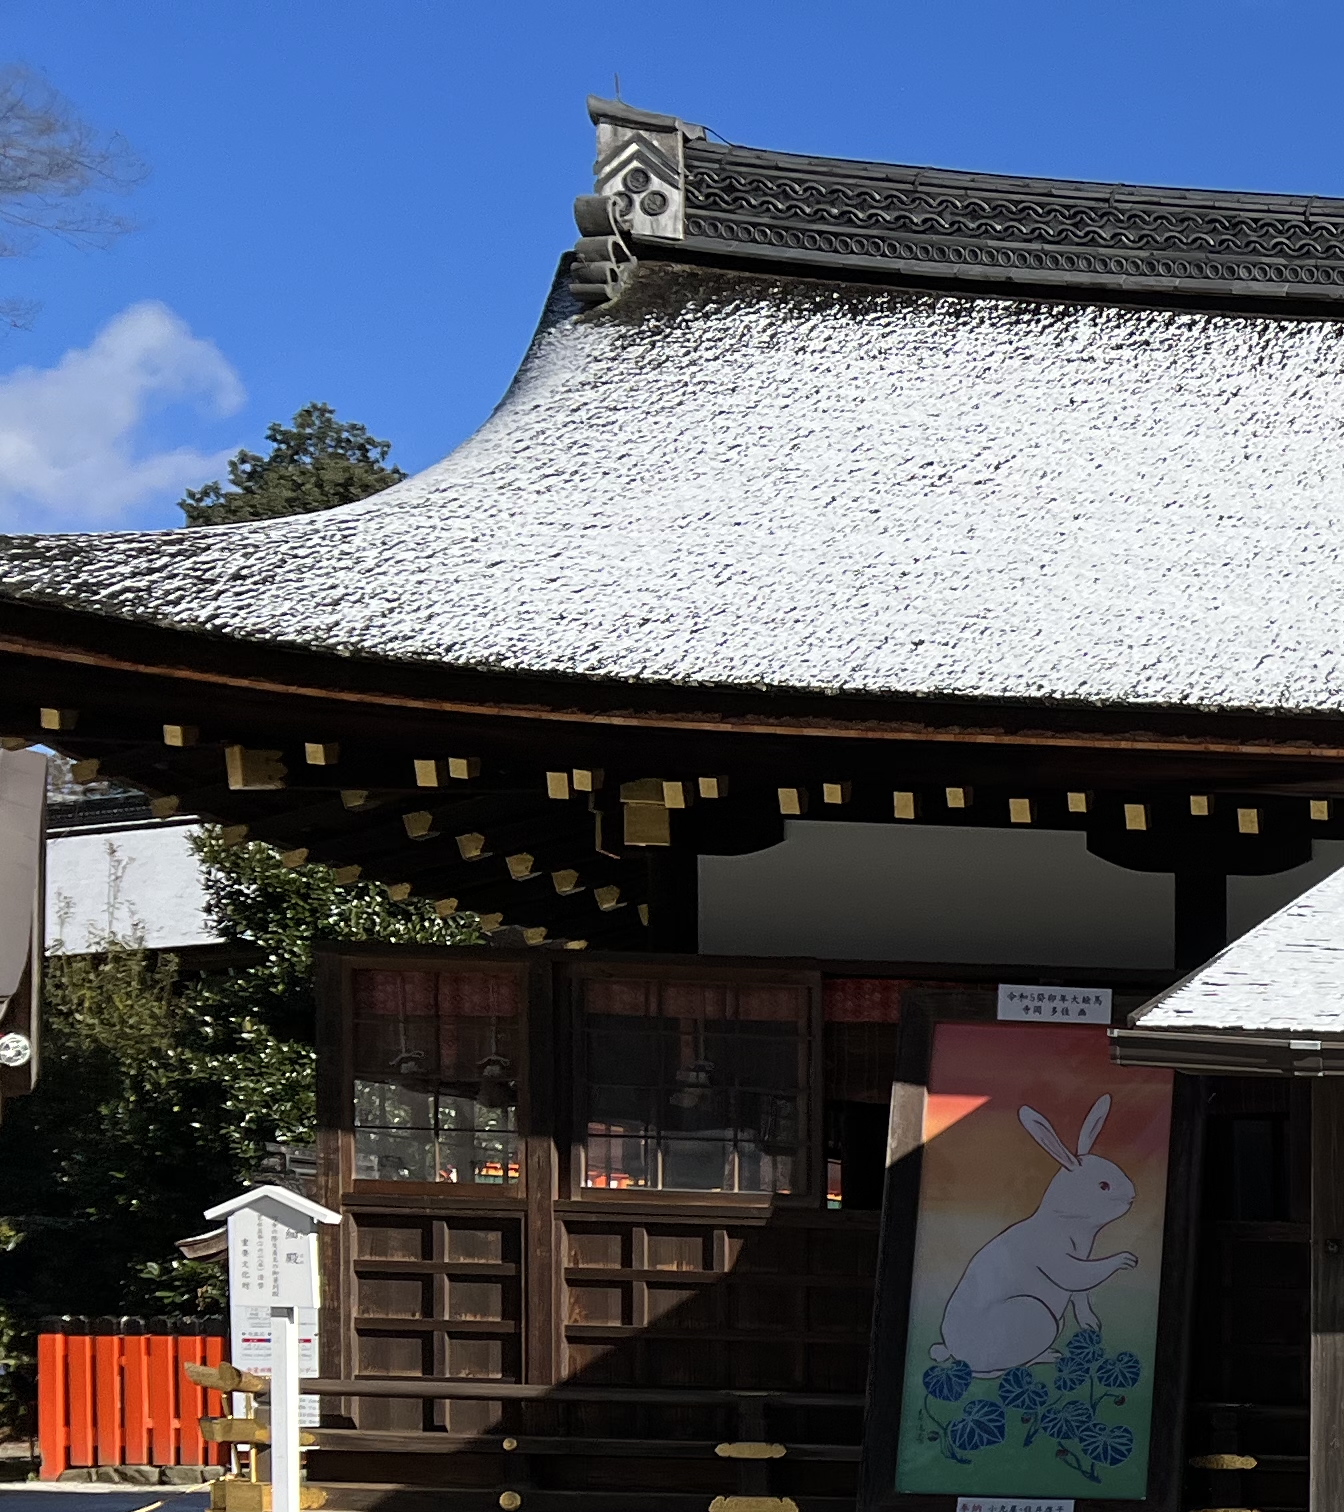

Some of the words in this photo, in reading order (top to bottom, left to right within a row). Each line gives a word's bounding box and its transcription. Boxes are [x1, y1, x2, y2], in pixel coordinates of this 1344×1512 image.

[1007, 991, 1103, 1006] 令和5癸卯年大絵馬
[241, 1238, 250, 1290] 重要文化財
[961, 1503, 983, 1512] 奉納
